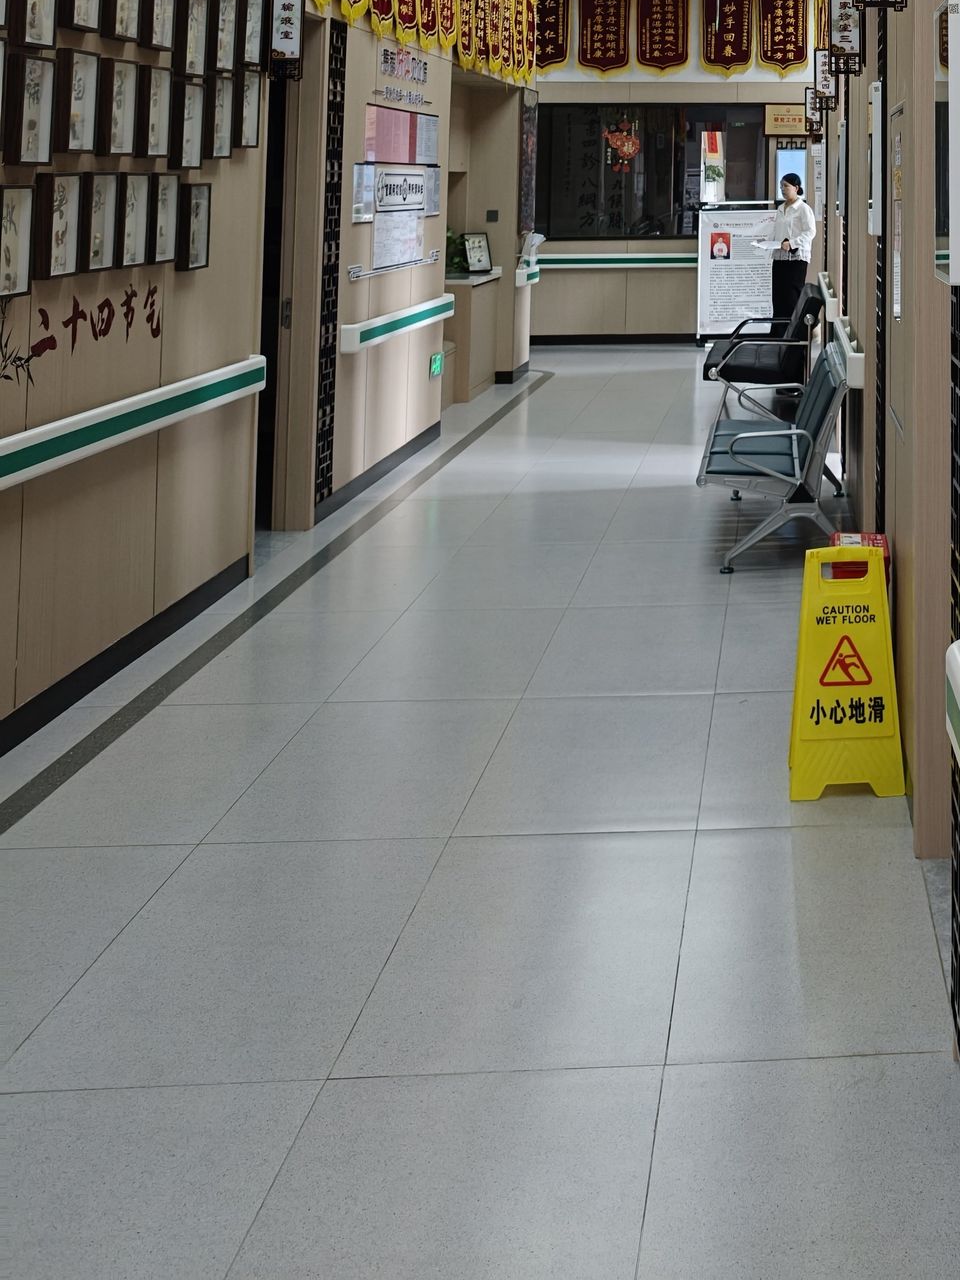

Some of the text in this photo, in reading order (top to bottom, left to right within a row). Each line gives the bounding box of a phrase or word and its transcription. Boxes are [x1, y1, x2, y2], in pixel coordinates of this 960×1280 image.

[280, 2, 294, 40] 输液室
[545, 0, 556, 54] 仁心仁术
[722, 1, 736, 57] 妙手回春
[31, 279, 162, 358] 二十四节气
[816, 614, 876, 625] WET FLOOR
[822, 604, 870, 615] CAUTION
[810, 696, 886, 726] 小心地滑
